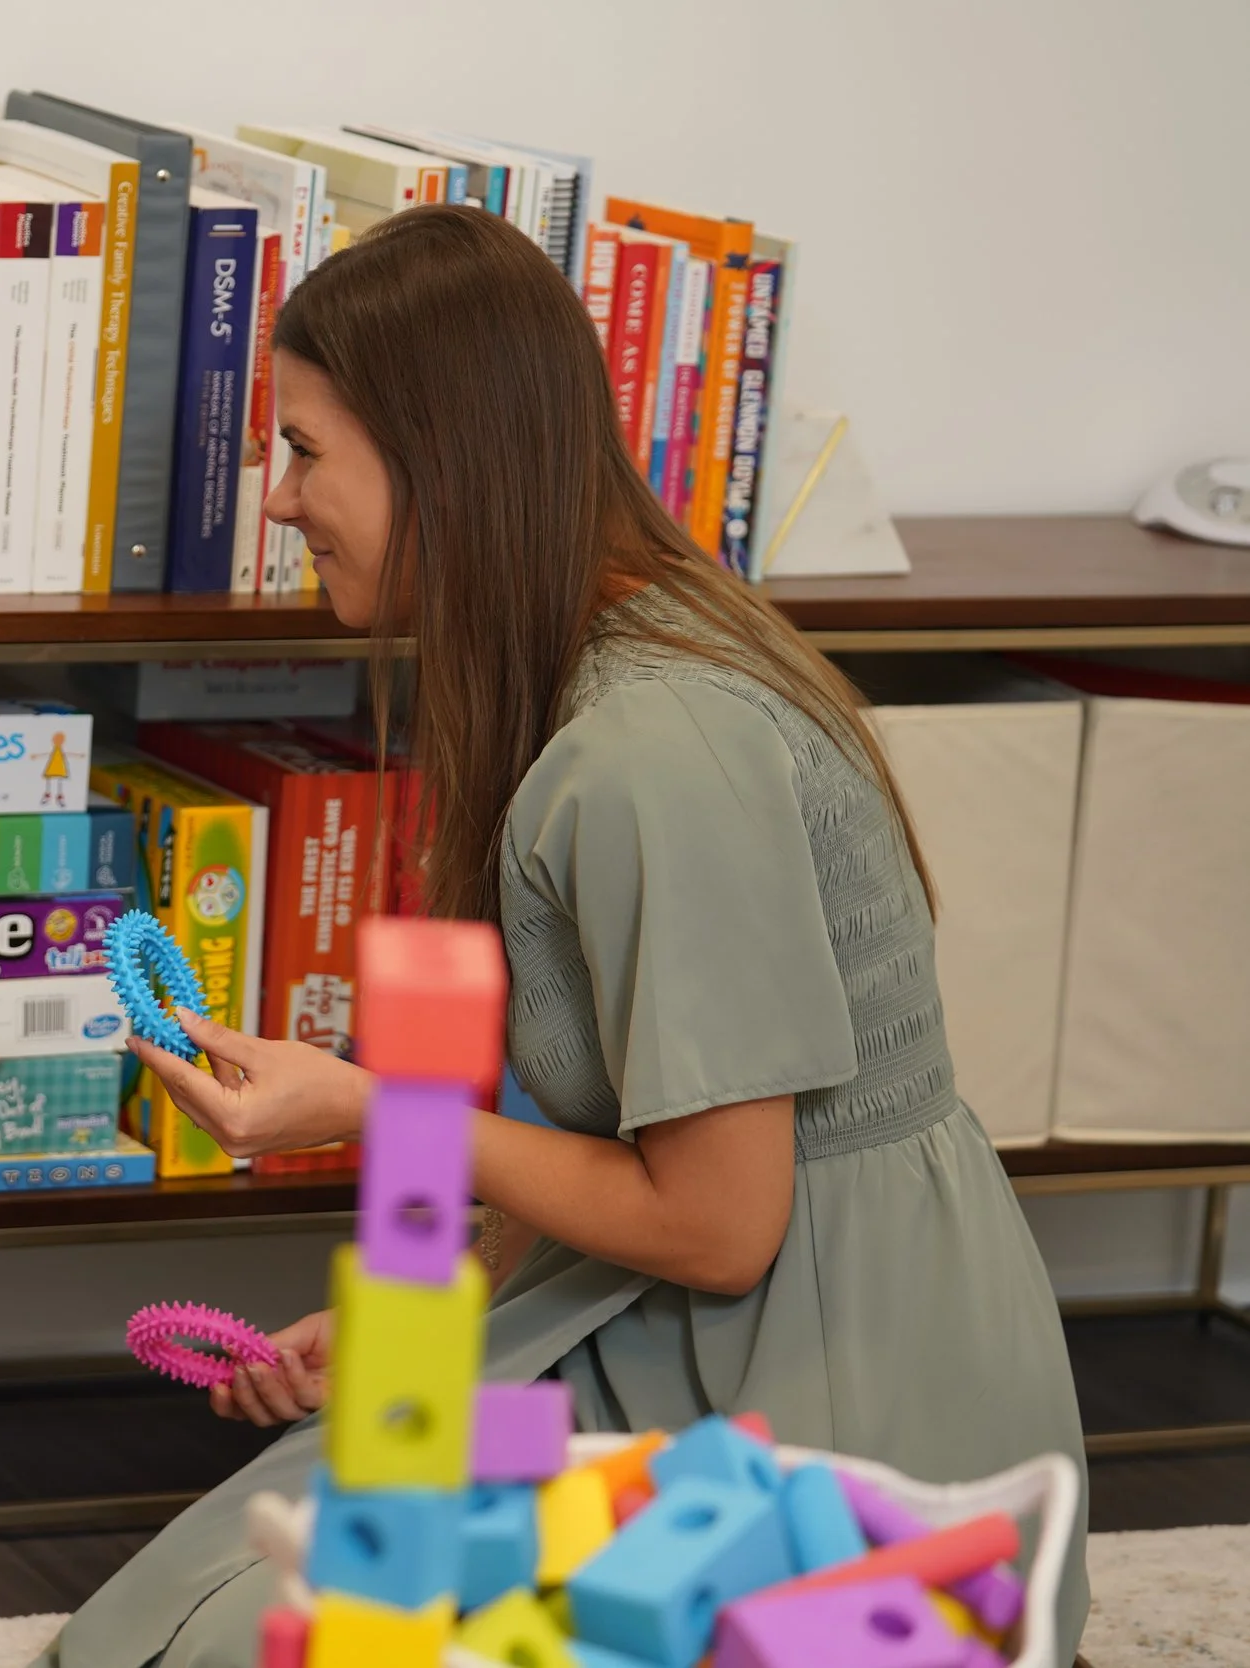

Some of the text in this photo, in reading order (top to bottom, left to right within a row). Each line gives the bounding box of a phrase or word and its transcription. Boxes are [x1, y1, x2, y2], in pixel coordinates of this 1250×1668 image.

[589, 240, 616, 288] HOW
[100, 181, 133, 425] Creative Family Therapy Techniques
[587, 294, 612, 319] TO
[624, 263, 648, 335] COME
[621, 340, 640, 374] AS
[713, 293, 745, 460] POWER OF DISCORD
[219, 370, 235, 438] DIAGNOSTIC
[727, 272, 774, 509] UNTAMED GLENNON DOYLE
[207, 419, 220, 436] OF
[205, 436, 218, 479] MENTAL
[217, 439, 230, 466] AND
[300, 836, 320, 917] THE FIRST
[315, 798, 343, 953] KINESTHETIC GAME
[336, 875, 354, 900] ITS
[334, 904, 352, 927] OF
[200, 936, 235, 1007] DOING
[317, 976, 336, 1015] OUT
[29, 1093, 46, 1112] of
